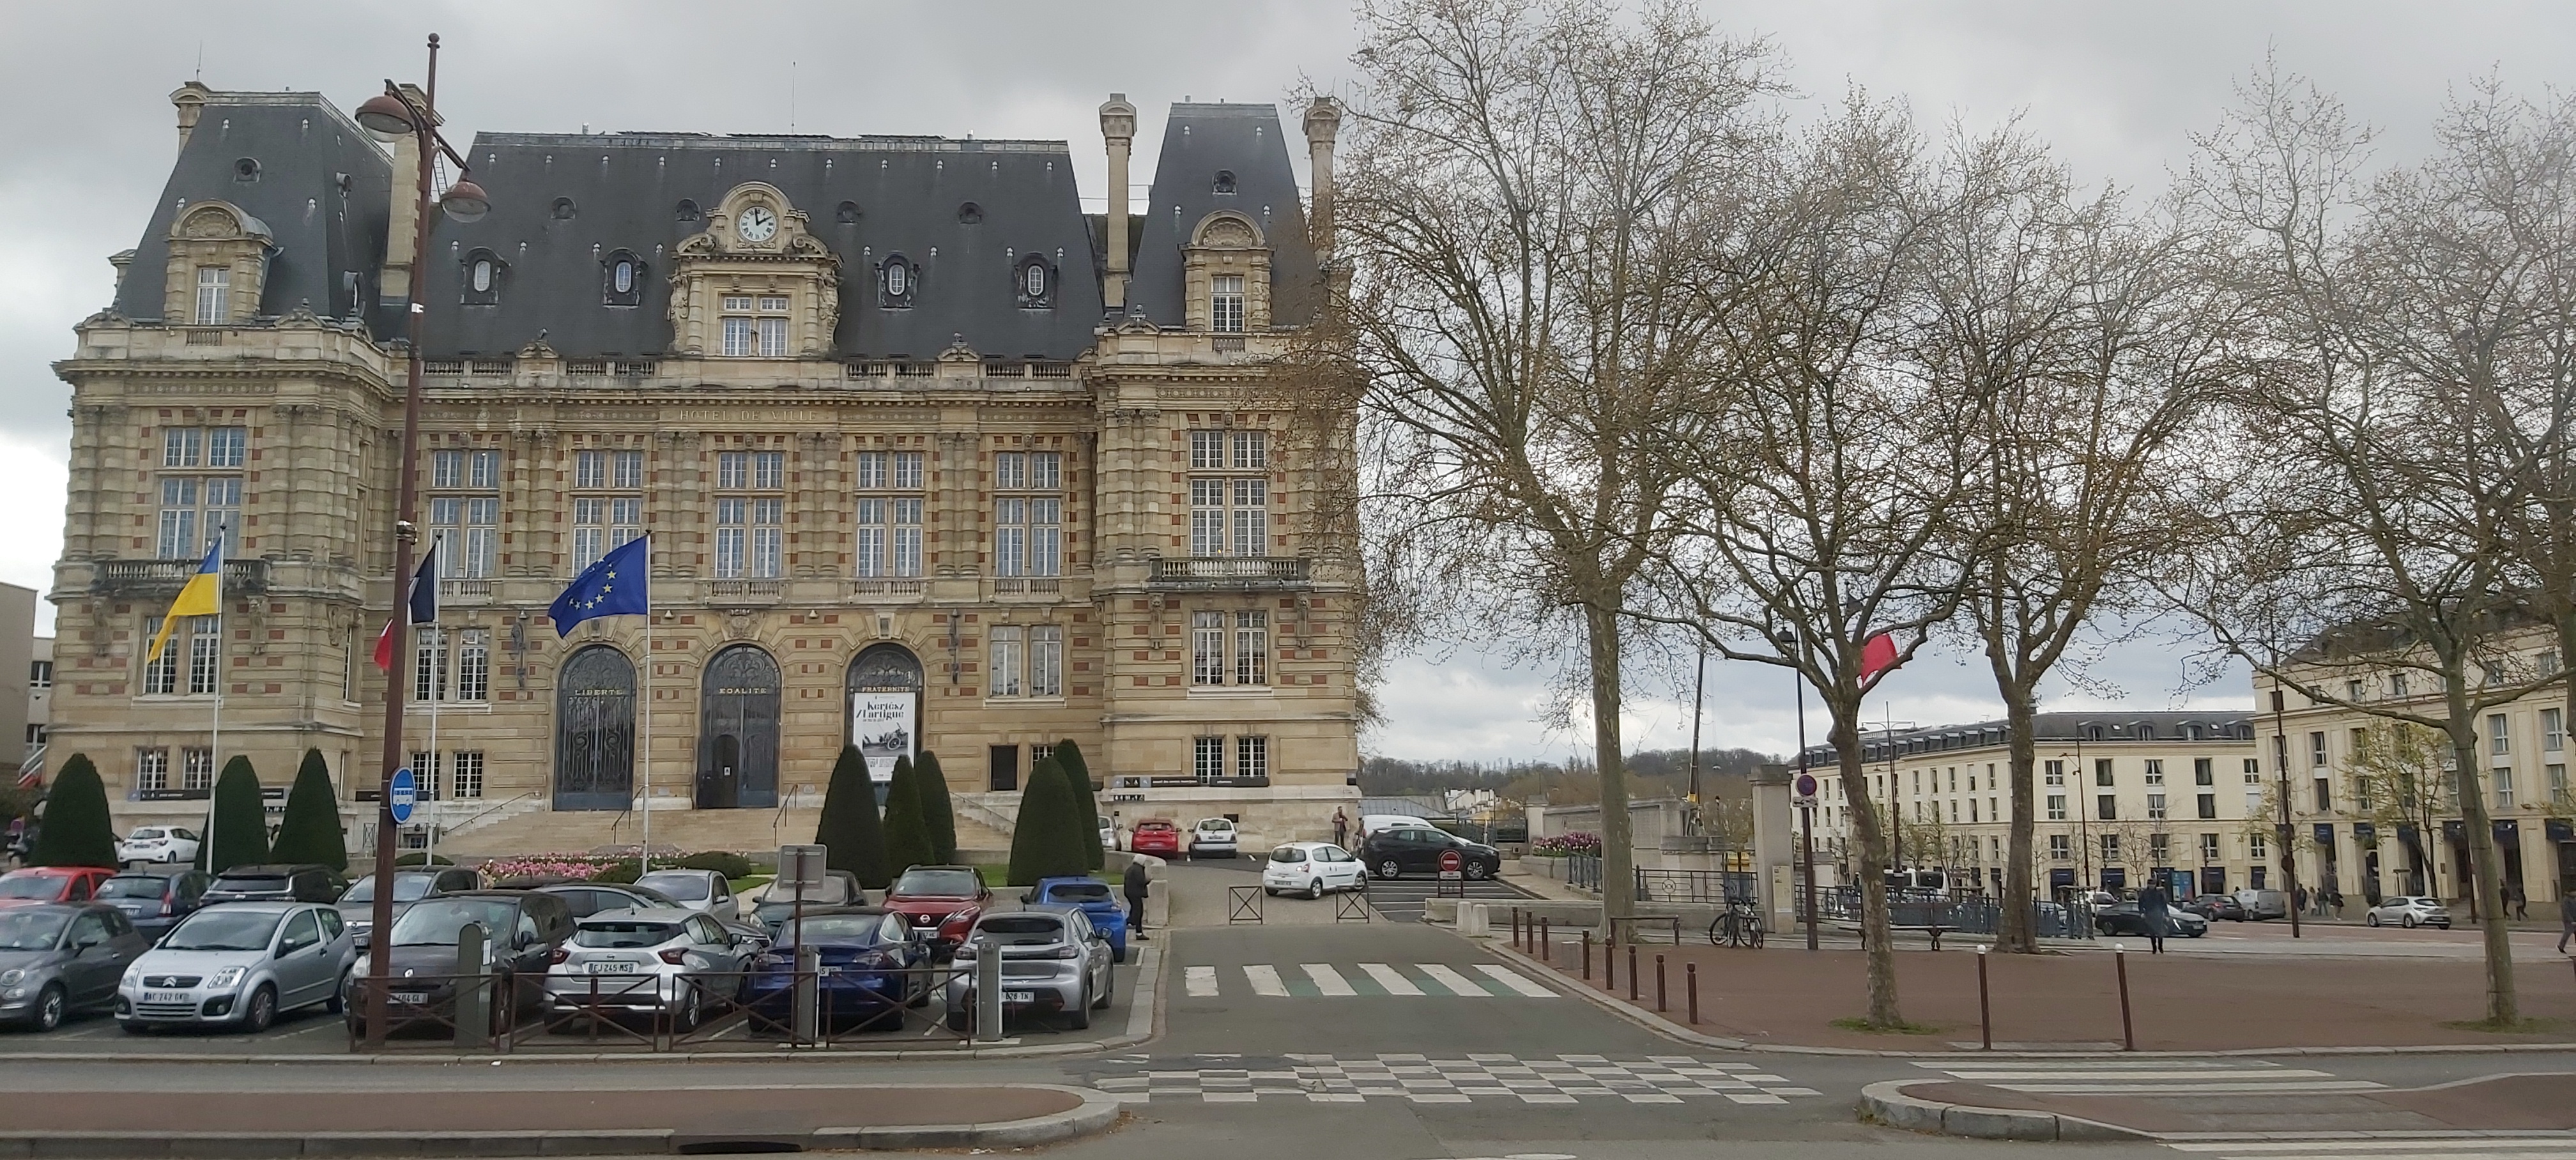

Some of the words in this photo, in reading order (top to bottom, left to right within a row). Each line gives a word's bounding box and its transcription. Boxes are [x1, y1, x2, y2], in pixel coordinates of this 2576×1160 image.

[680, 409, 730, 422] HOTEL
[741, 409, 761, 422] DE
[771, 409, 817, 422] VILLE
